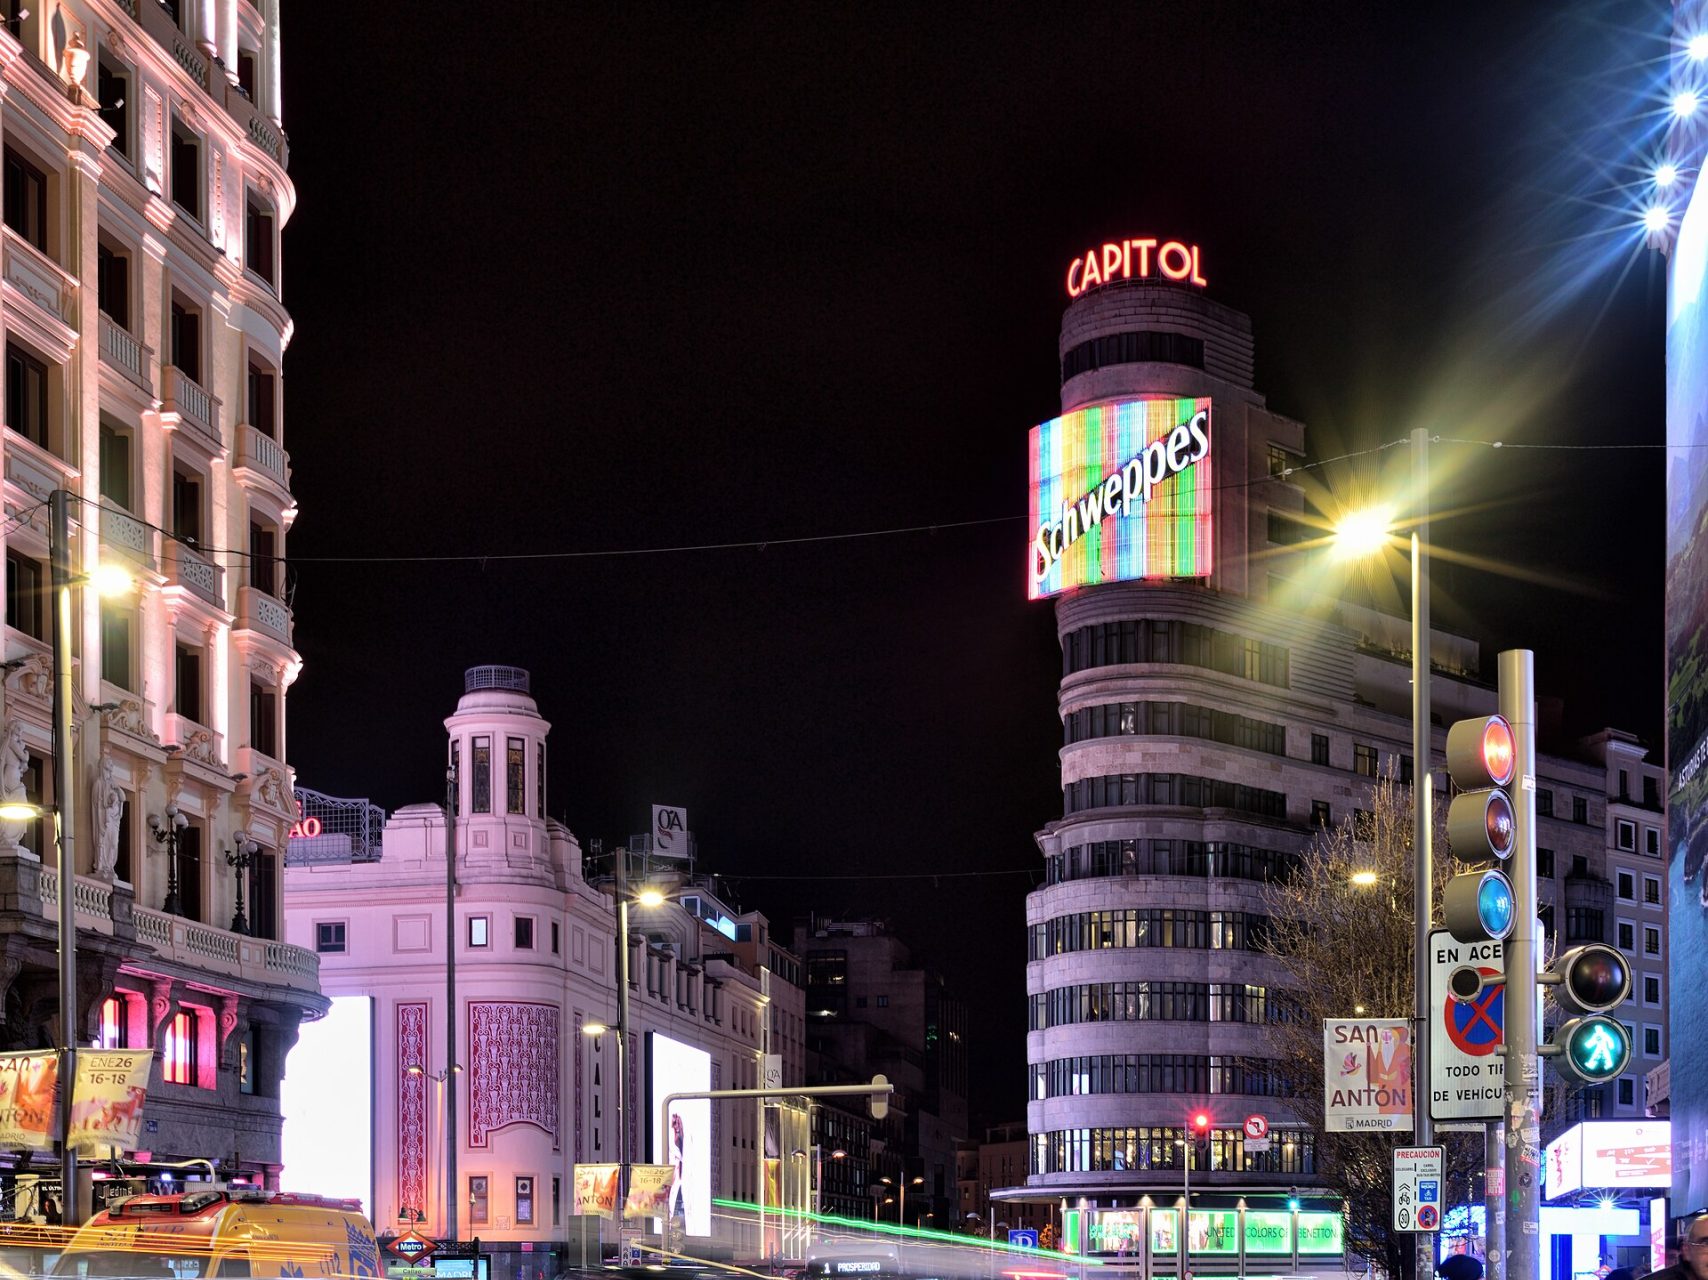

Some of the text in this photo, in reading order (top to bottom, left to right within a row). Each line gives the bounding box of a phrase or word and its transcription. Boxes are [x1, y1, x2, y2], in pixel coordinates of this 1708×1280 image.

[1067, 239, 1207, 297] CAPITOL
[1034, 411, 1209, 583] Schweppes
[1437, 948, 1459, 963] EN
[1334, 1024, 1378, 1044] SAN
[90, 1057, 133, 1068] ENE26
[1446, 1065, 1480, 1077] TODO
[90, 1073, 126, 1085] 16-18
[1331, 1084, 1406, 1107] ANTÓN
[1433, 1091, 1449, 1101] DE
[1356, 1119, 1393, 1128] MADRID
[1245, 1227, 1277, 1239] COLORS
[400, 1242, 422, 1251] Metro
